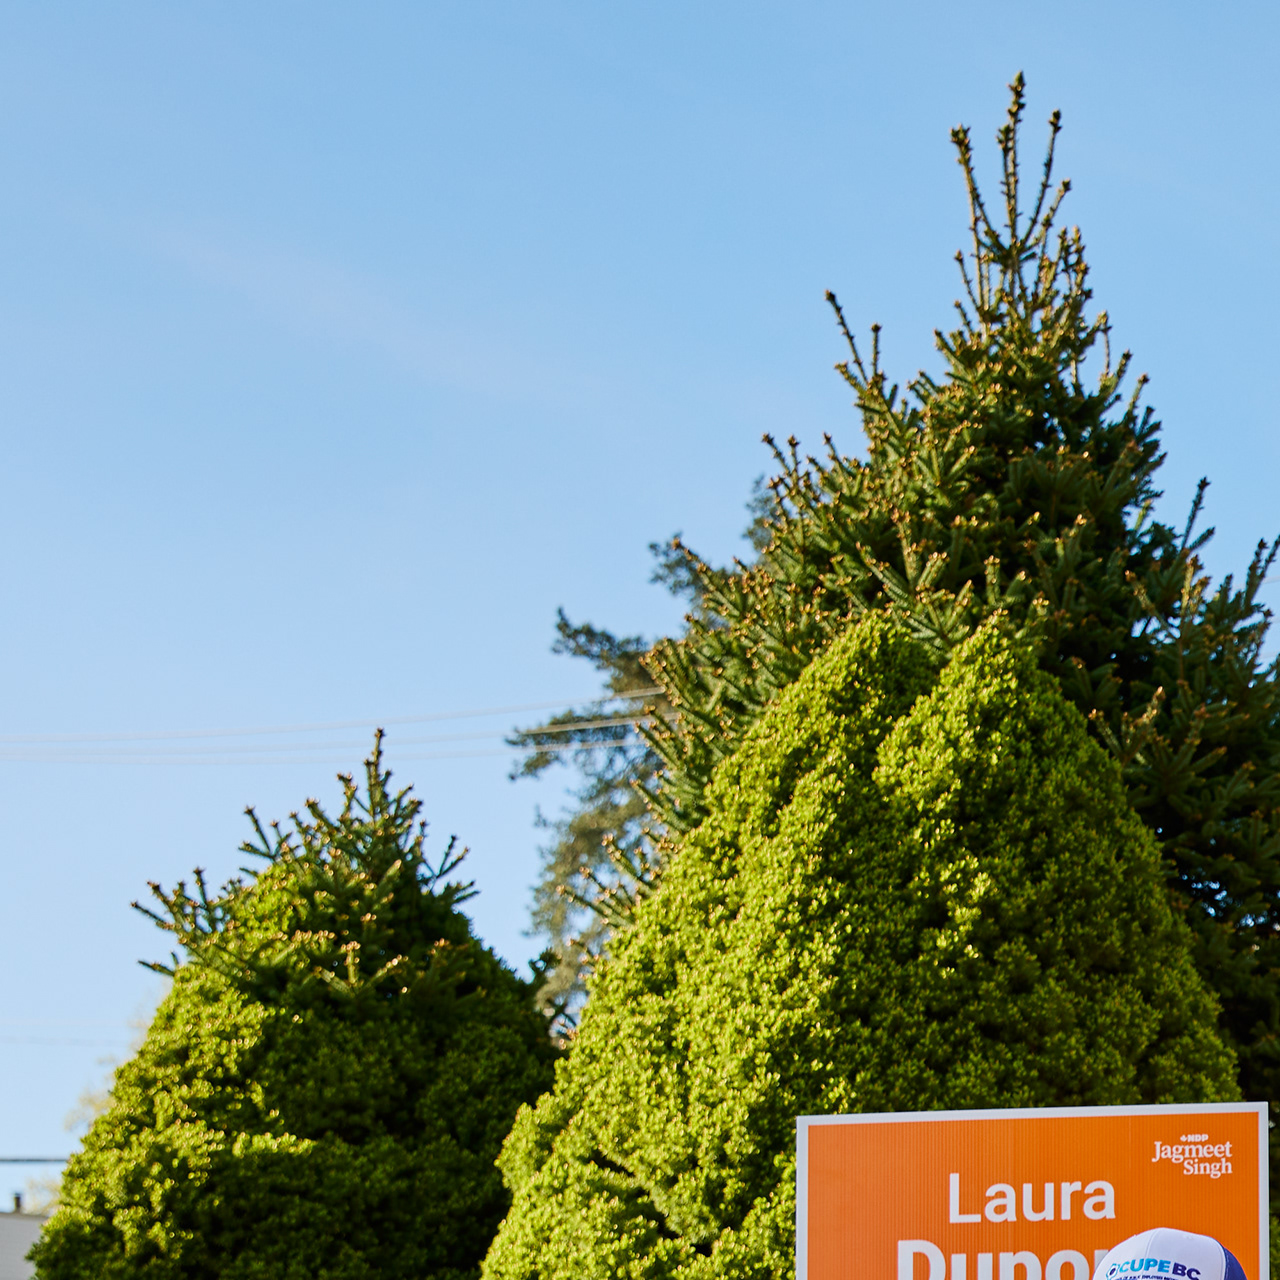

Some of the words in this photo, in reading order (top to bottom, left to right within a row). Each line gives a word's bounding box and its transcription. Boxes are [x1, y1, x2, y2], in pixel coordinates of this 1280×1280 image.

[1187, 1134, 1209, 1142] NDP
[1151, 1140, 1233, 1167] Jagmeet
[1183, 1158, 1233, 1179] Singh
[949, 1172, 1116, 1224] Laura
